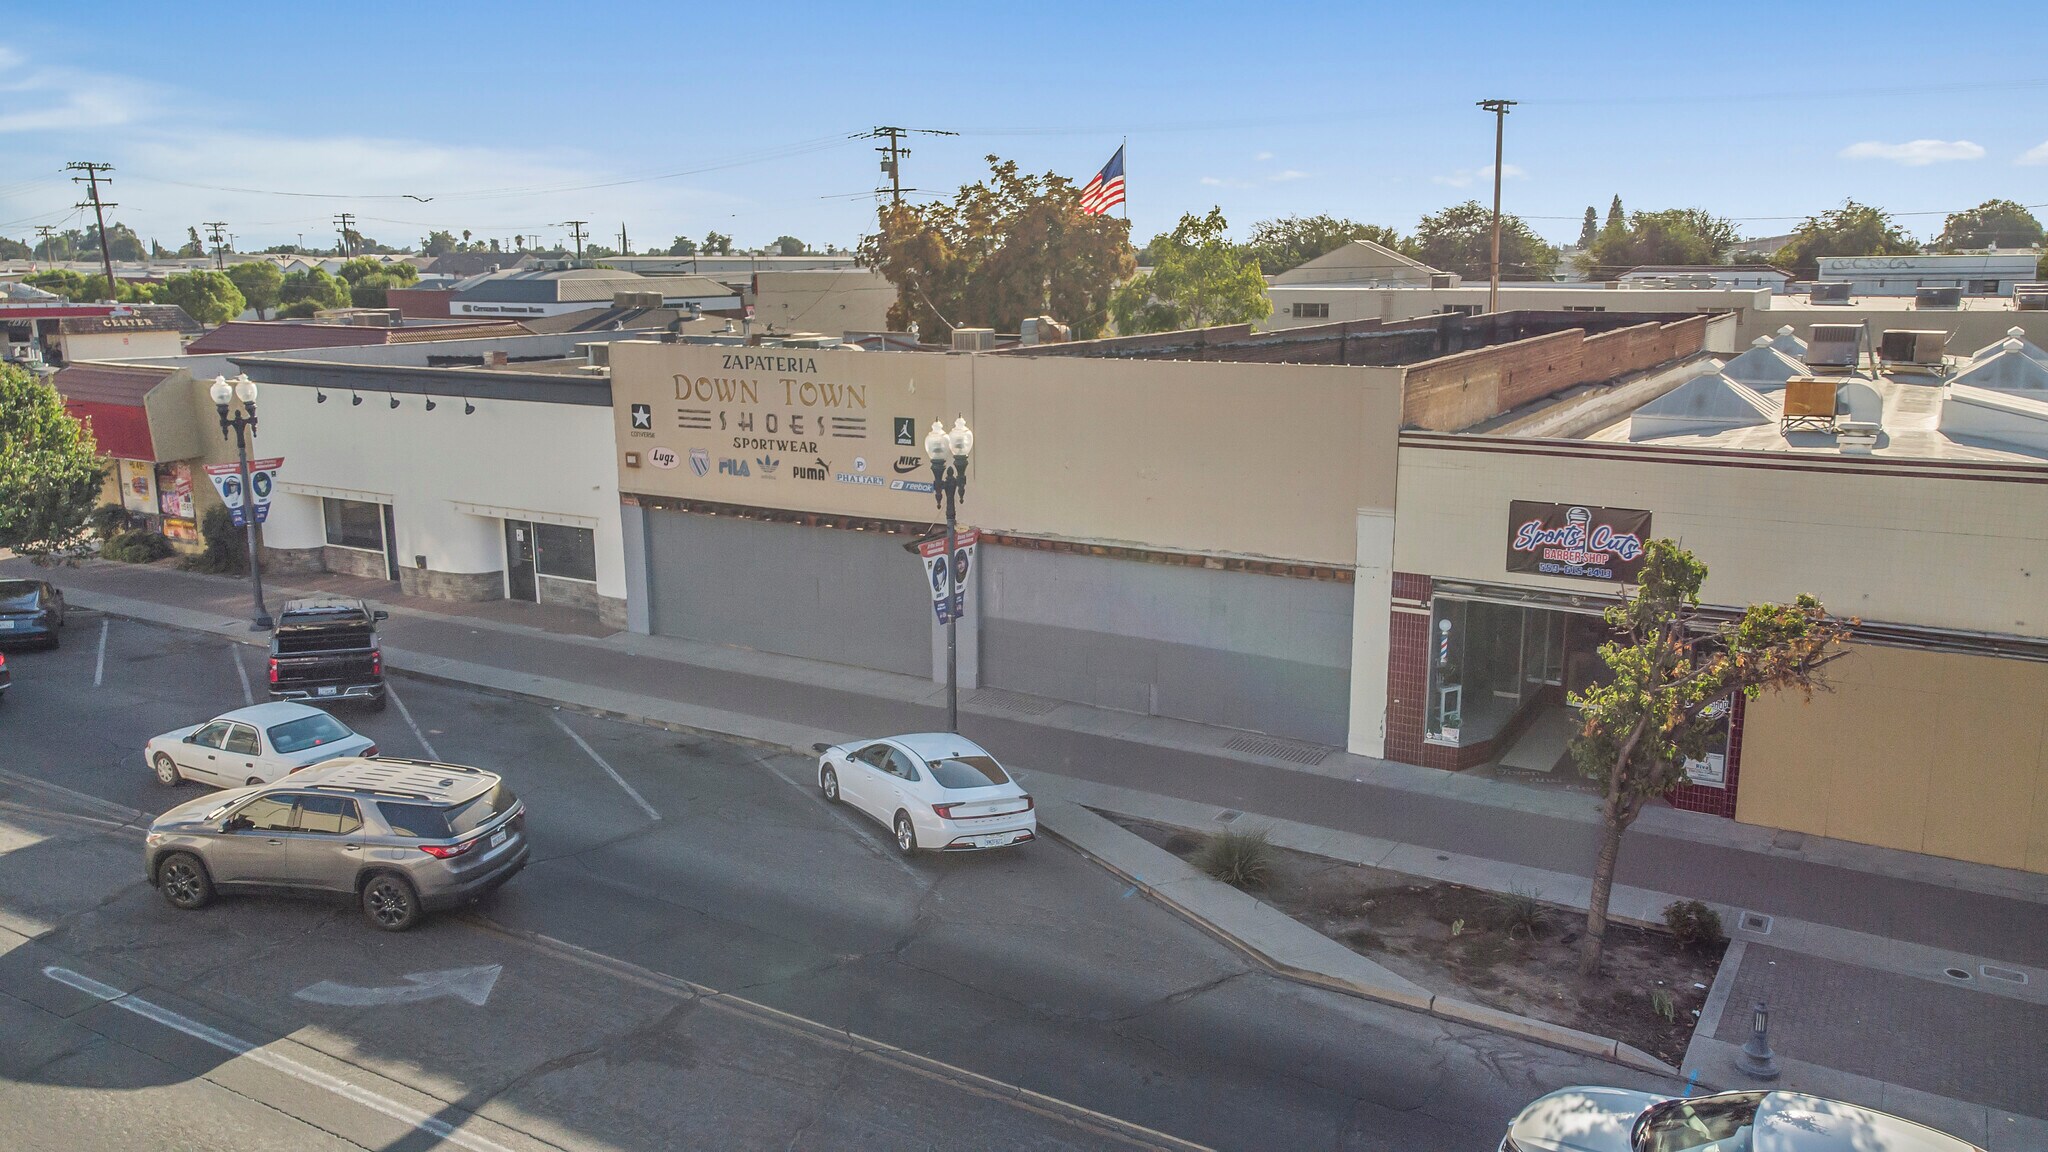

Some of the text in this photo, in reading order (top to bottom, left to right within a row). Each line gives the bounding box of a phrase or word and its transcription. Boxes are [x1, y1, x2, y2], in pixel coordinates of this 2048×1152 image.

[103, 319, 153, 327] CENTER
[722, 355, 817, 373] ZAPATERIA
[672, 374, 867, 409] DOWN TOWN
[719, 411, 825, 436] SHOES
[733, 436, 818, 454] SPORTWEAR
[653, 449, 674, 466] Lugz
[899, 456, 921, 466] NIKE
[718, 457, 750, 477] FILA
[793, 466, 825, 480] PUMA
[1514, 521, 1642, 561] Sports Cuts
[1543, 548, 1609, 565] BARBER SHOP
